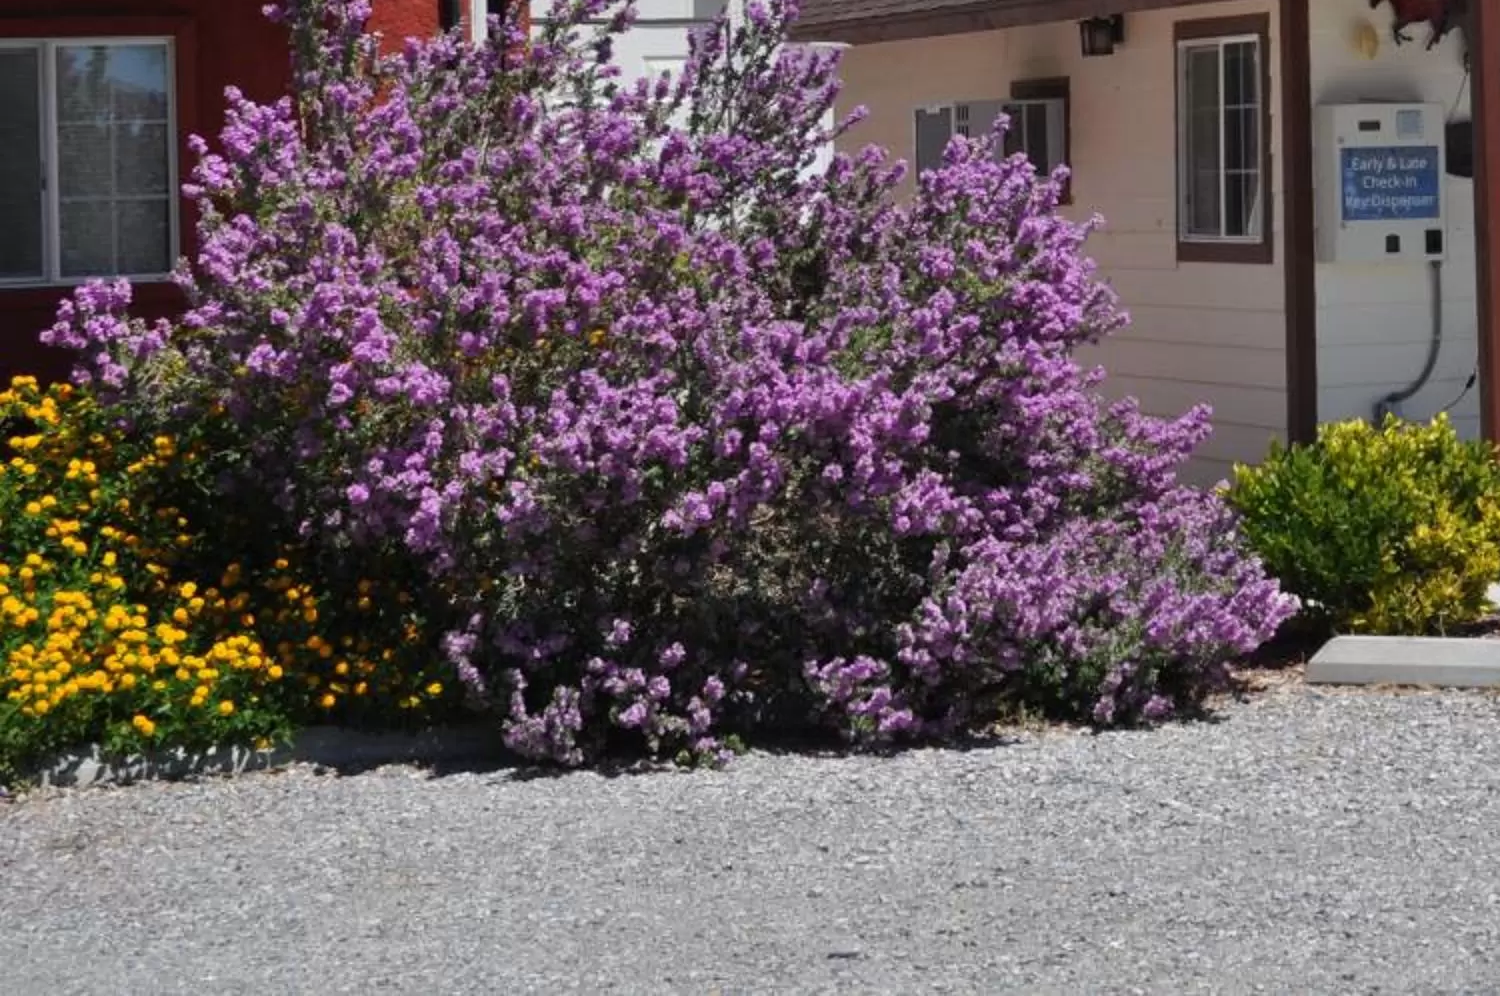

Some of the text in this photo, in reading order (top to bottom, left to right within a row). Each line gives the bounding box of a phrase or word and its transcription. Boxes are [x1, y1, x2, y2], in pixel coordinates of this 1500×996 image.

[1351, 157, 1428, 173] Early & Late
